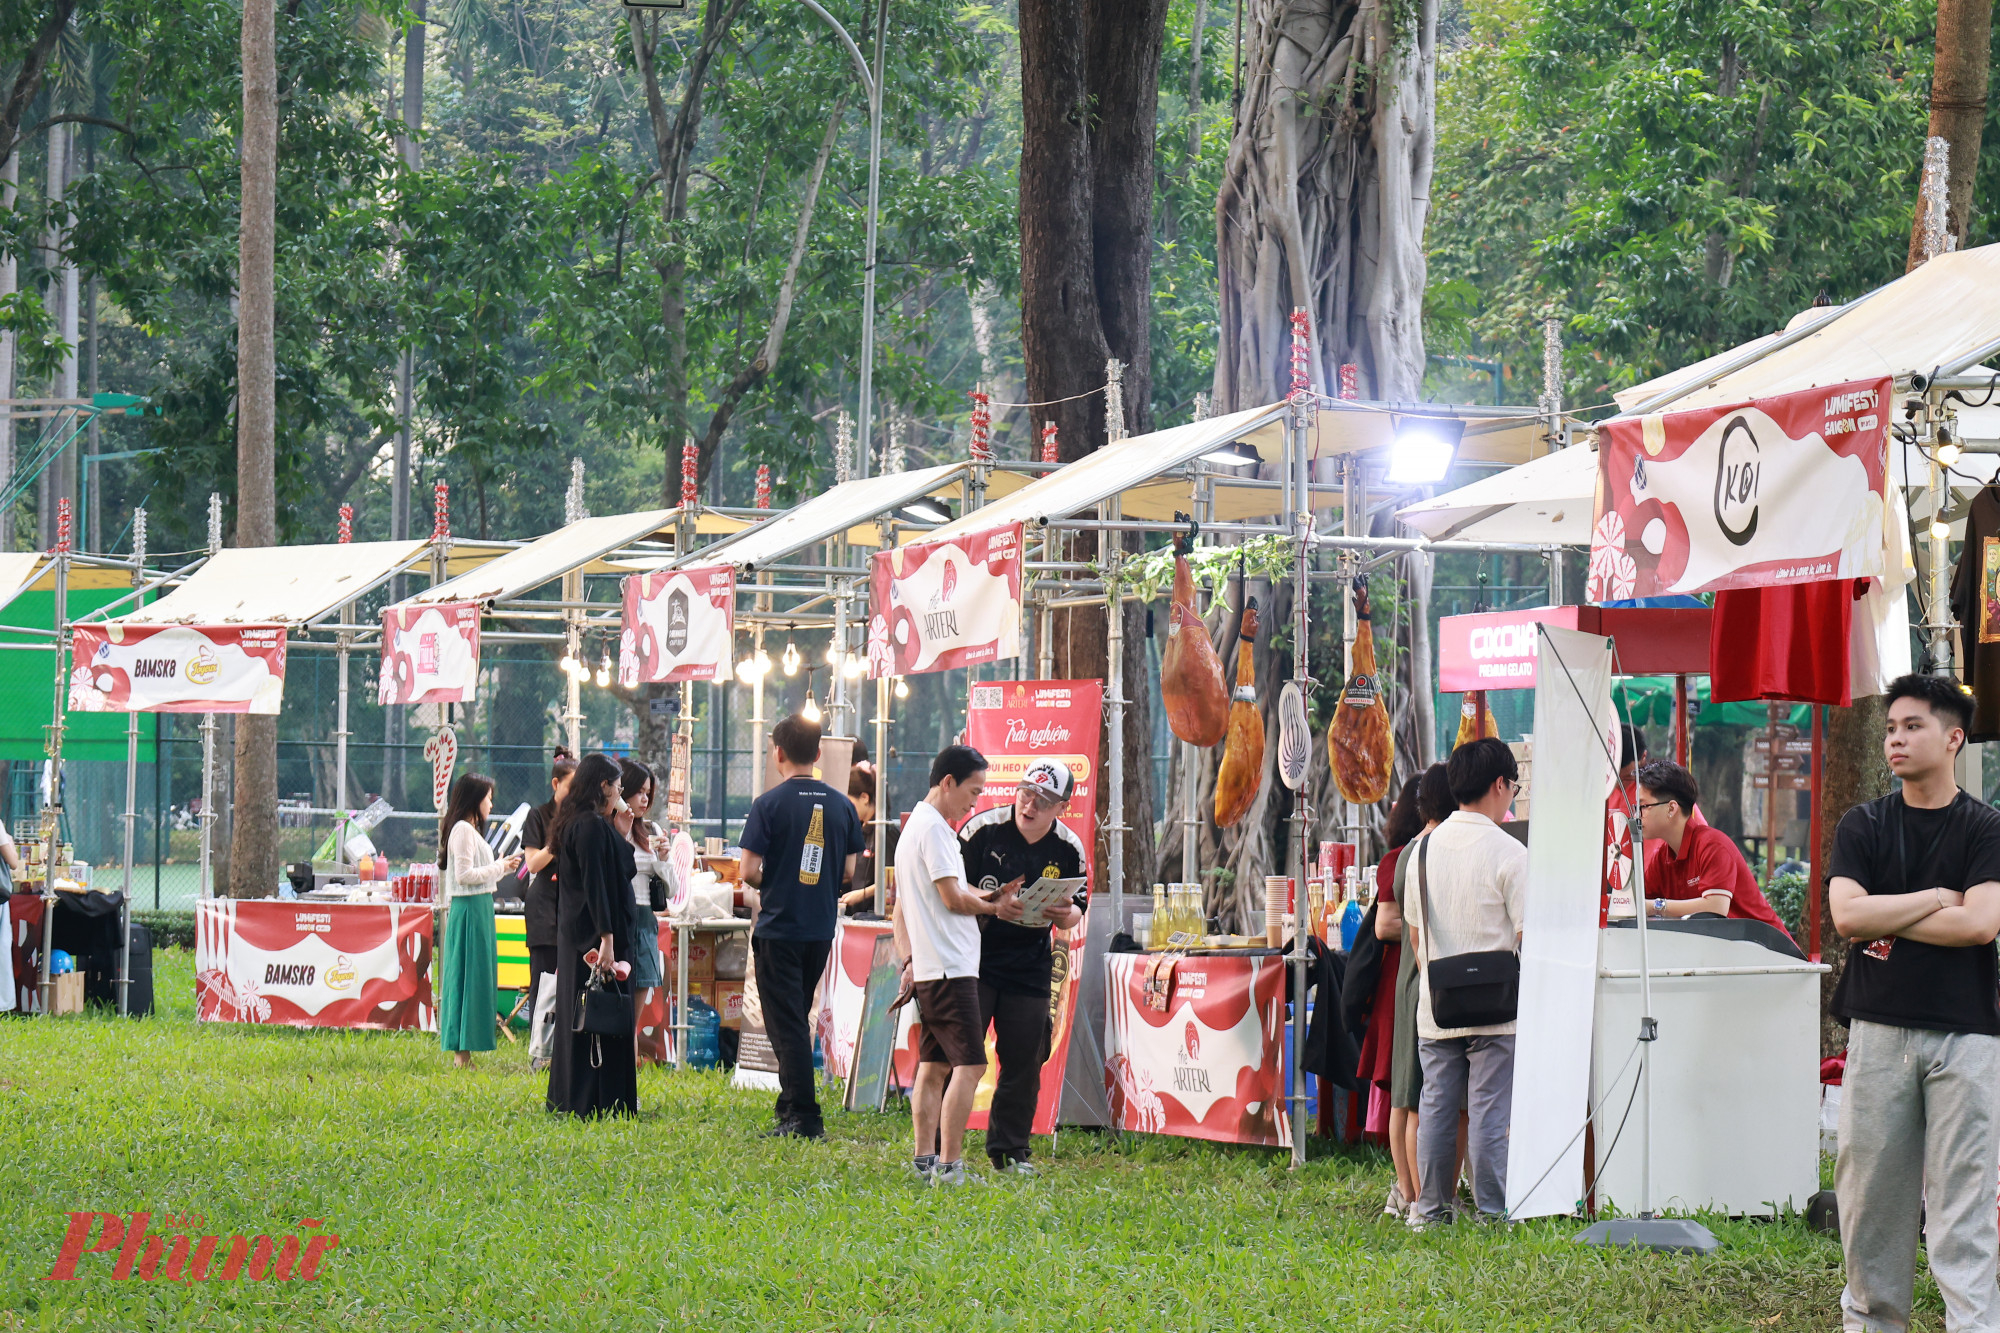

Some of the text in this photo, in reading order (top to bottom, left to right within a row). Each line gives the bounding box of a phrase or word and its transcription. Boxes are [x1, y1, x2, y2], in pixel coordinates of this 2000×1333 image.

[1824, 418, 1857, 436] SAIGON
[924, 609, 959, 641] ARTERI
[134, 658, 177, 678] BAMSK8
[191, 661, 217, 676] Joyeux
[1479, 662, 1533, 677] PREMIUM GELATO
[1028, 720, 1071, 749] nghiệm
[1002, 763, 1021, 772] HEO
[808, 845, 820, 873] AMBER
[1044, 866, 1059, 878] BVB
[264, 963, 316, 986] BAMSK8
[1173, 1067, 1212, 1093] ARTERI
